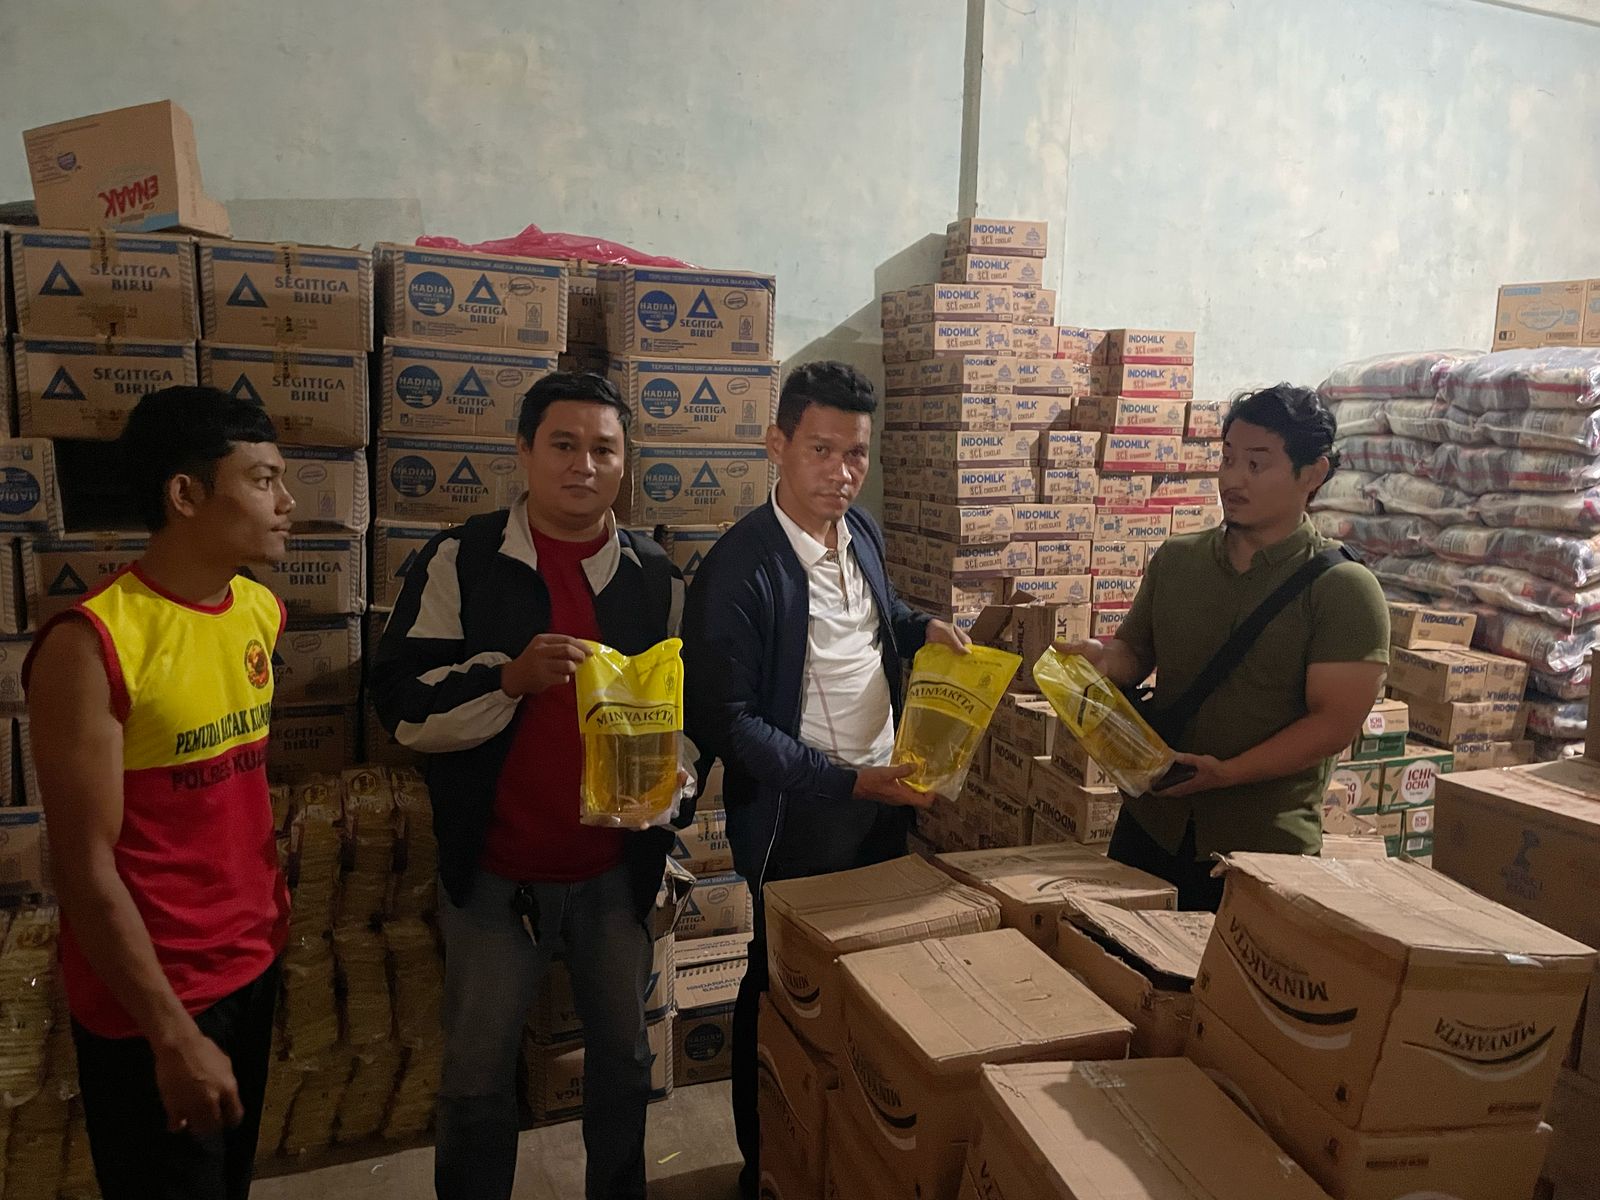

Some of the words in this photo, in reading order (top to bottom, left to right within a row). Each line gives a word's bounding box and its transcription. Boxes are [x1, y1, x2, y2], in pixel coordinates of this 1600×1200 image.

[98, 175, 158, 218] ENAAK
[973, 223, 1014, 235] INDOMILK
[970, 259, 1010, 270] INDOMILK
[90, 263, 171, 278] SEGITIGA
[112, 278, 153, 292] BIRU
[275, 276, 349, 293] SEGITIGA
[411, 283, 453, 294] HADIAH
[569, 285, 597, 295] SEGI
[294, 292, 333, 305] BIRU
[938, 290, 980, 299] INDOMILK
[458, 303, 508, 316] SEGITIGA
[639, 301, 676, 311] HADIAH
[470, 314, 496, 325] BIRU
[679, 318, 724, 329] SEGITIGA
[690, 328, 716, 338] BIRU
[938, 327, 980, 337] INDOMILK
[1129, 335, 1165, 344] INDOMILK
[965, 357, 997, 366] INDOMILK
[93, 367, 173, 382] SEGITIGA
[1018, 364, 1040, 375] MILK
[1128, 368, 1165, 378] INDOMILK
[272, 375, 345, 390] SEGITIGA
[400, 376, 440, 388] HADIAH
[290, 389, 329, 402] BIRU
[643, 389, 679, 398] HADIAH
[446, 396, 495, 408] SEGITIGA
[963, 397, 997, 405] INDOMILK
[1016, 400, 1038, 410] MILK
[458, 406, 484, 415] BIRU
[684, 405, 727, 414] SEGITIGA
[1121, 403, 1158, 414] INDOMILK
[694, 414, 718, 423] BIRU
[961, 436, 1003, 447] INDOMILK
[1050, 434, 1081, 443] INDOMILK
[1110, 438, 1151, 449] INDOMILK
[646, 473, 680, 482] HADIAH
[961, 473, 1005, 484] INDOMILK
[1046, 471, 1079, 480] INDOMILK
[439, 485, 489, 495] SEGITIGA
[684, 488, 726, 497] SEGITIGA
[451, 494, 478, 504] BIRU
[694, 496, 717, 505] BIRU
[961, 509, 991, 517] INDOMILK
[1016, 510, 1061, 520] INDOMILK
[1175, 508, 1201, 516] INDOMILK
[1128, 527, 1167, 537] INDOMILK
[956, 547, 1000, 558] INDOMILK
[1038, 543, 1072, 552] INDOMILK
[1094, 544, 1126, 552] INDOMILK
[272, 560, 341, 574] SEGITIGA
[289, 573, 326, 585] BIRU
[1016, 581, 1058, 590] INDOMILK
[1096, 580, 1137, 590] INDOMILK
[1421, 612, 1466, 627] INDOMILK
[1451, 665, 1486, 674] INDOMILK
[910, 687, 975, 714] MINYAKITA
[597, 709, 674, 729] MINYAKITA
[176, 721, 220, 755] PEMUDA
[1456, 743, 1491, 753] INDOMILK
[1408, 768, 1432, 781] ICHI
[1405, 779, 1429, 790] OCHA
[1035, 795, 1077, 833] INDOMILK
[697, 830, 727, 842] SEGI
[1090, 827, 1112, 840] MILK
[710, 840, 729, 851] BIR
[679, 915, 706, 924] ITIGA
[1230, 915, 1330, 1001] MINYAKITA
[1434, 1016, 1537, 1053] MINYAKITA
